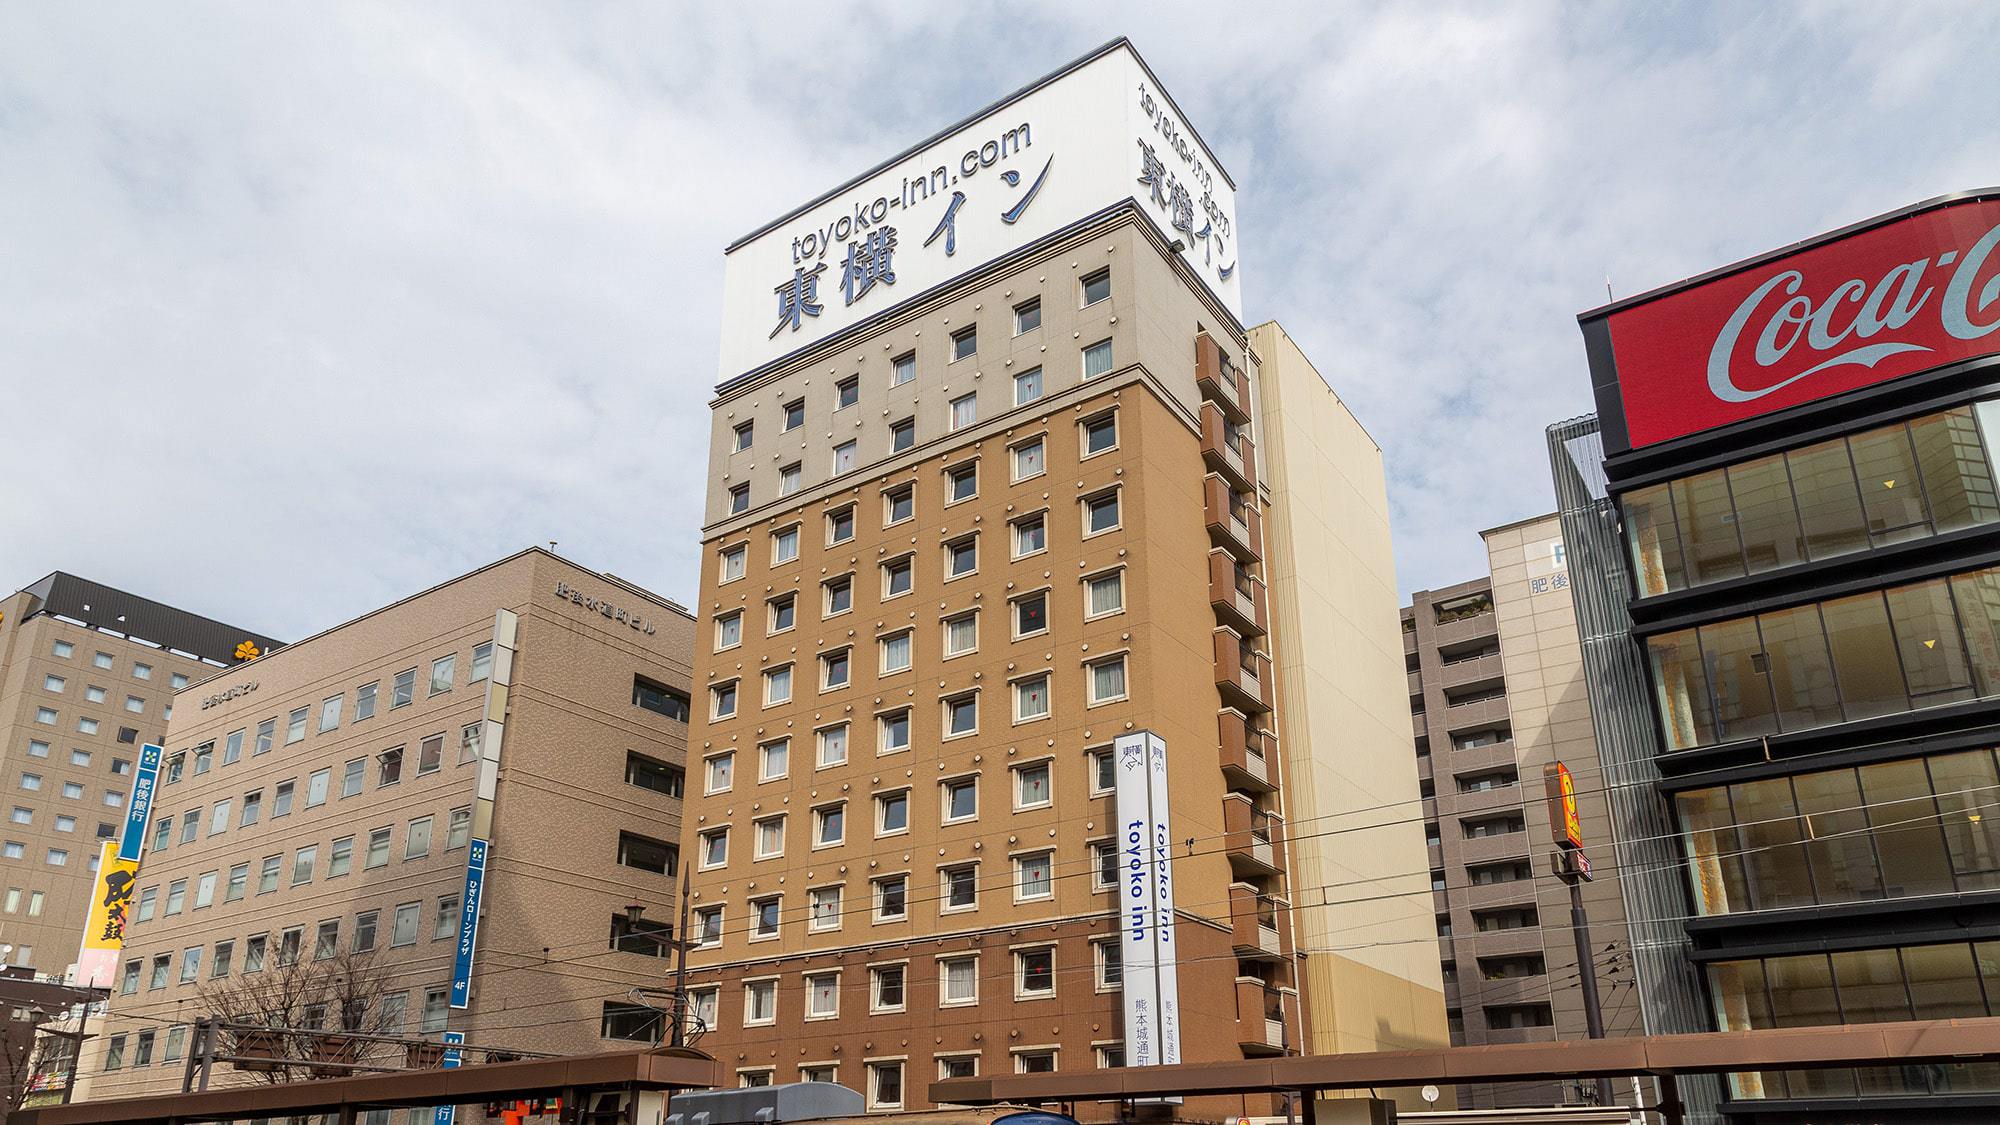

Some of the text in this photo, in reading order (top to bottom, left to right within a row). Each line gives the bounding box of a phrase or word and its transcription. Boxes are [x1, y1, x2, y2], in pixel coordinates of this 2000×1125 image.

[792, 121, 1032, 264] toyoko-inn.com
[1137, 137, 1236, 281] 東横イン
[1138, 82, 1231, 239] toyoko-inn.com
[768, 152, 1055, 340] 東横イン
[131, 777, 151, 822] 肥後銀行
[461, 880, 477, 955] ひぎんローンプラザ
[1126, 820, 1148, 941] toyoko inn
[1156, 823, 1170, 942] toyoko inn
[454, 981, 466, 991] 4F
